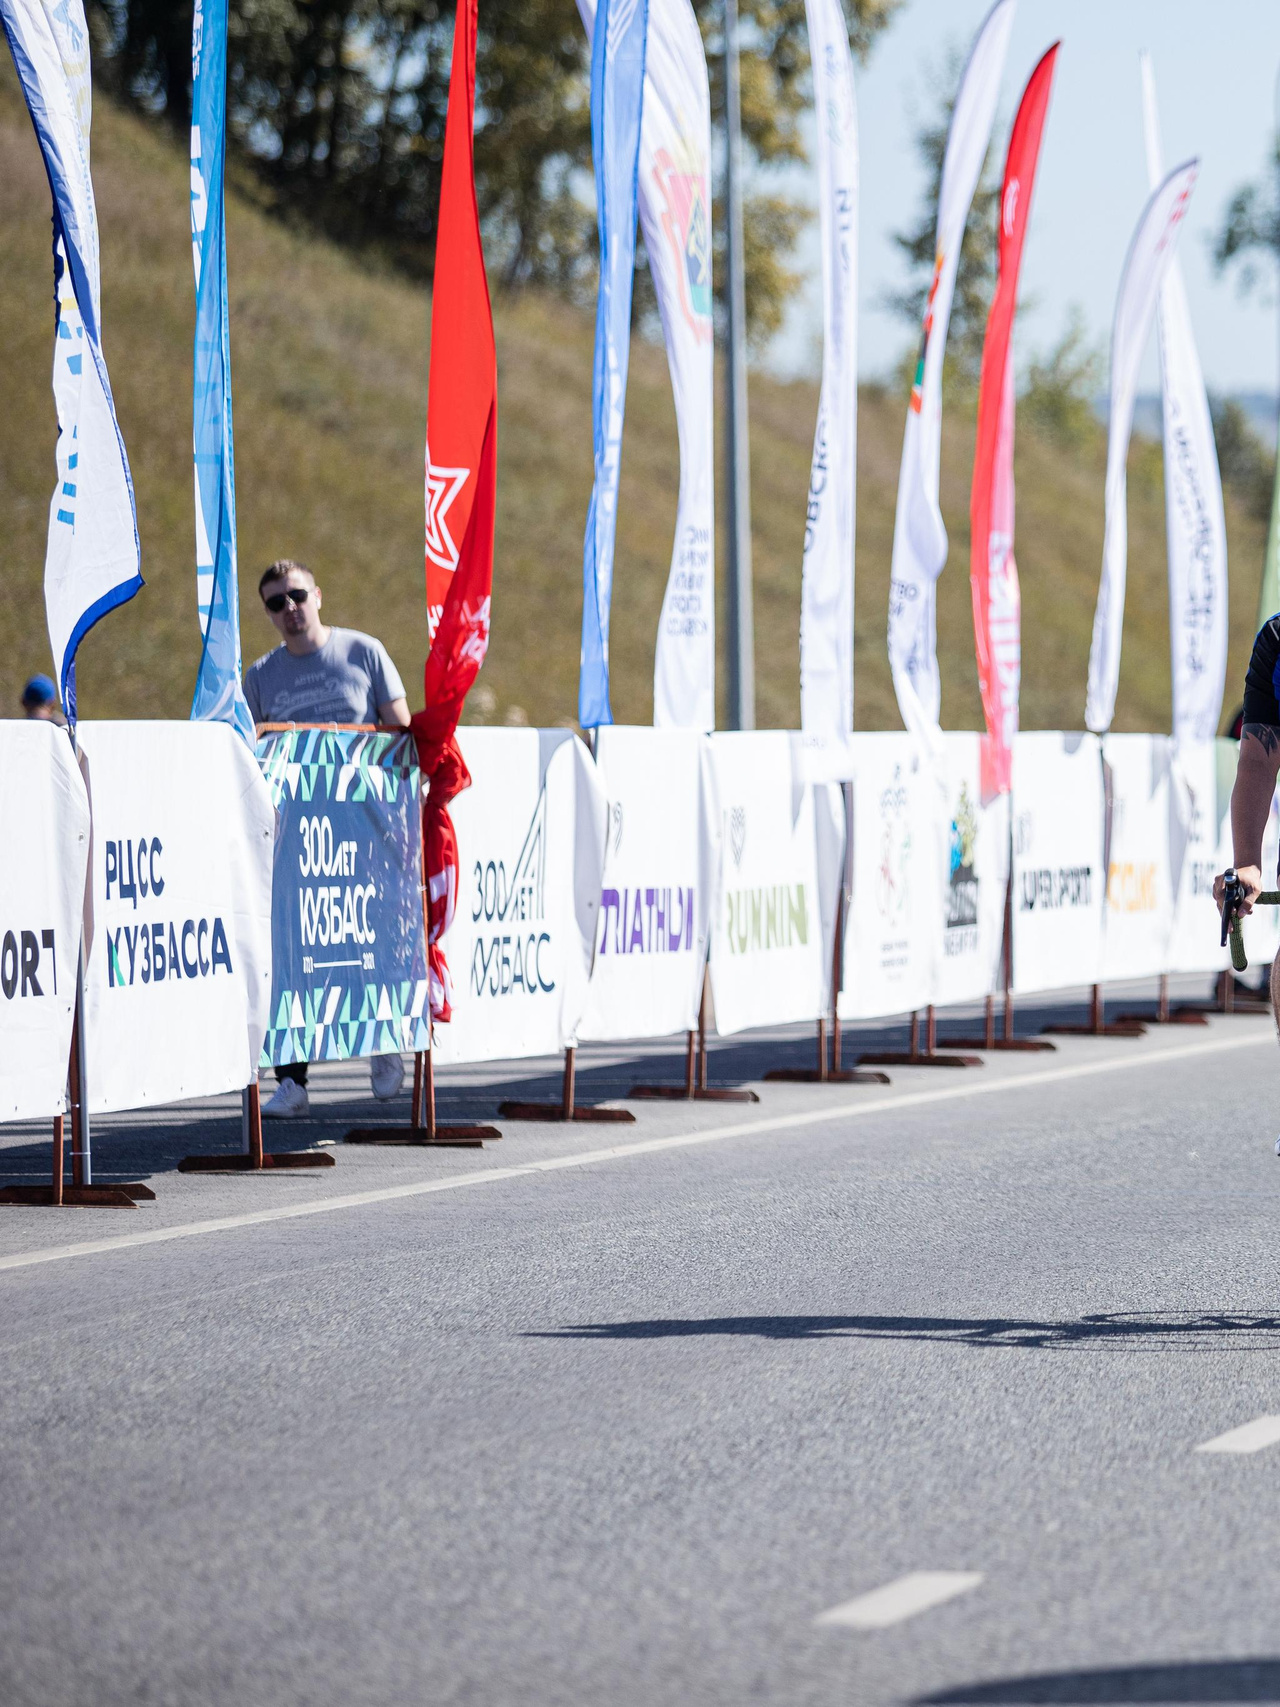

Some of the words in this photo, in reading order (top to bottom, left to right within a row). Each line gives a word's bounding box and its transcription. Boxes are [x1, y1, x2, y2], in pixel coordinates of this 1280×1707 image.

[105, 837, 165, 909] РЦСС
[299, 884, 376, 946] КУЗБАСС
[106, 918, 233, 988] КУЗБАССА
[471, 933, 555, 996] КУЗБАСС
